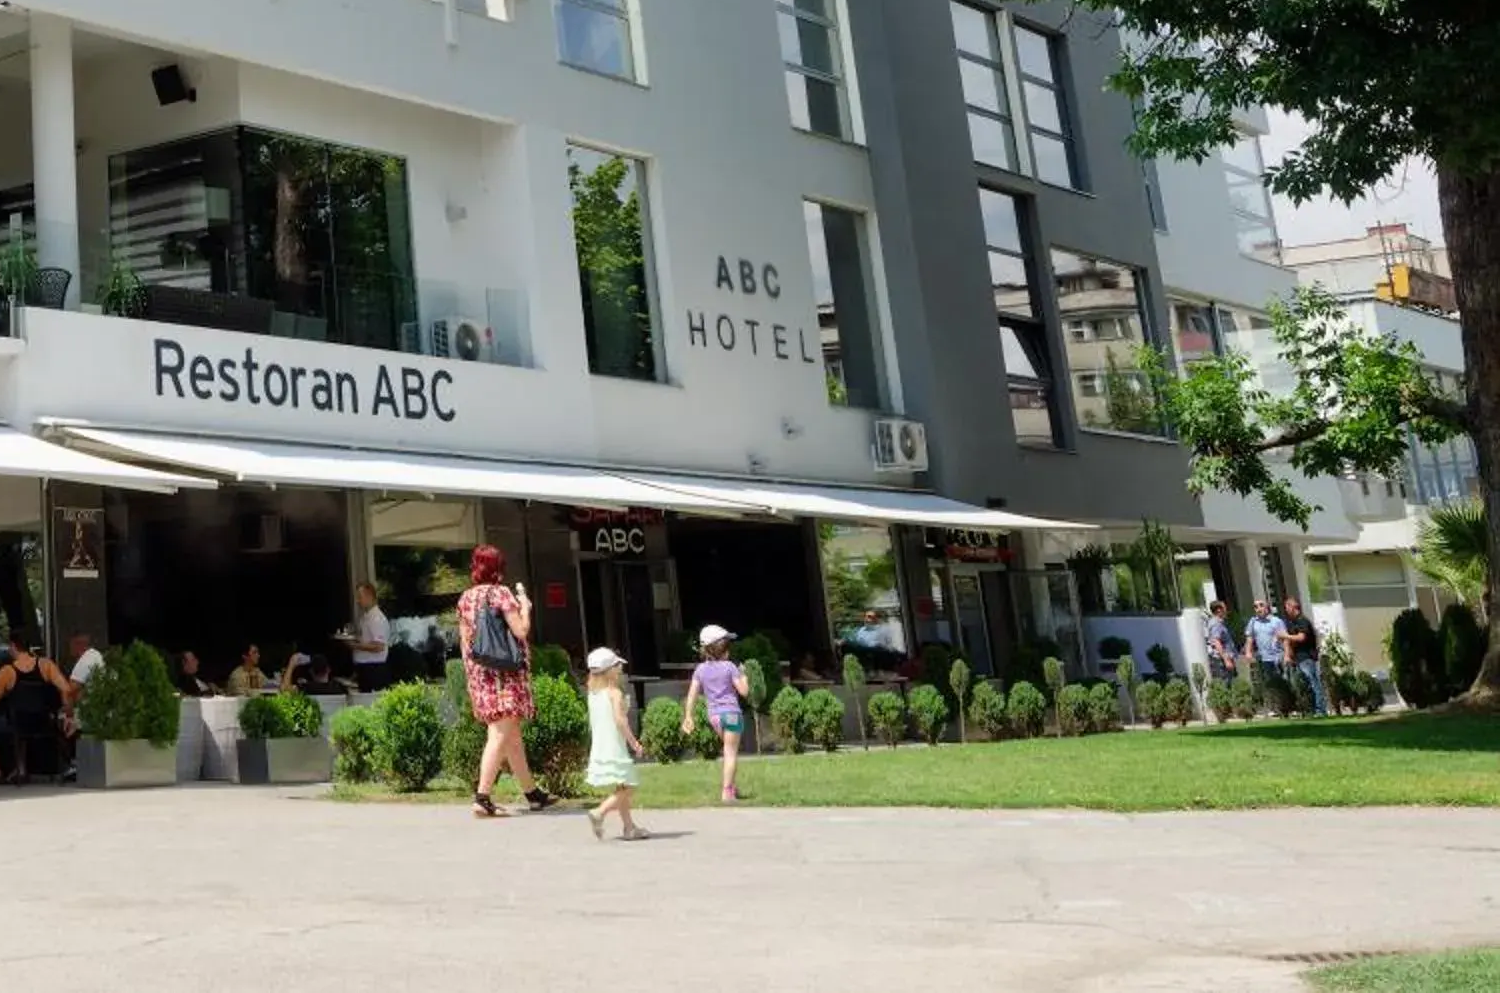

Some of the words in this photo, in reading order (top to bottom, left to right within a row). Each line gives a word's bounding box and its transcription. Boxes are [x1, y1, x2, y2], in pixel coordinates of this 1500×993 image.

[716, 255, 781, 299] ABC
[687, 309, 815, 364] HOTEL
[153, 338, 359, 414] Restoran
[371, 364, 456, 422] ABC
[595, 527, 645, 554] ABC
